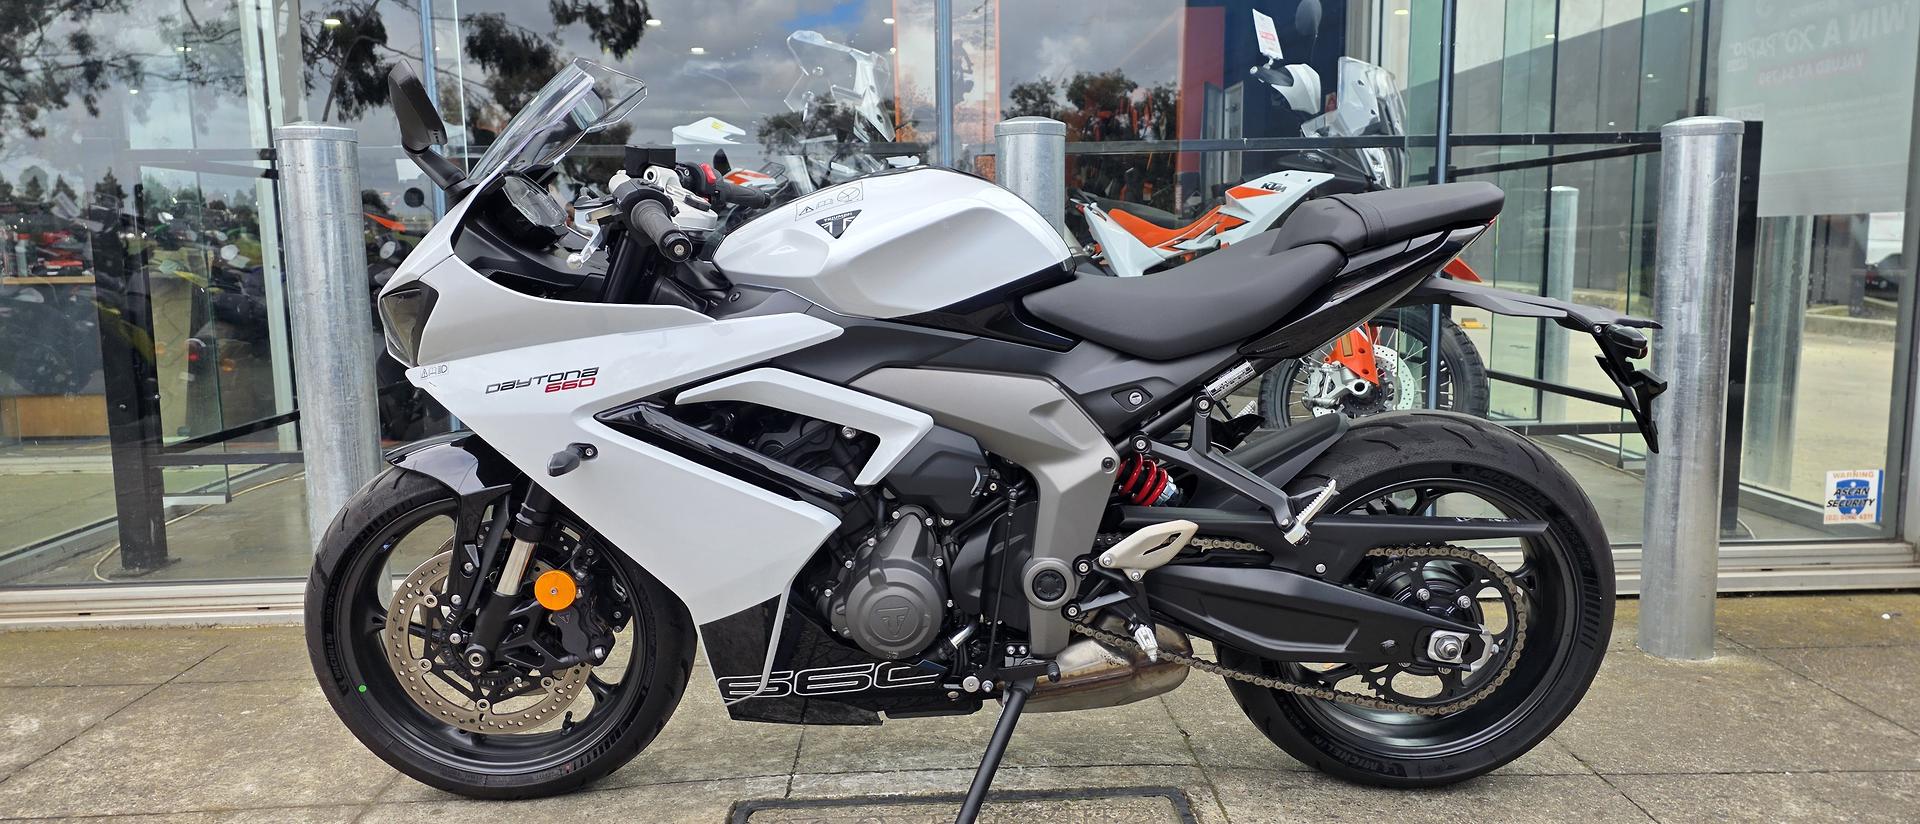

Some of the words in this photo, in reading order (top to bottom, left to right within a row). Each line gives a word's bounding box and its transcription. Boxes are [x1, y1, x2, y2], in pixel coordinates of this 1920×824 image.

[1261, 182, 1287, 192] KTM
[544, 377, 596, 393] 660
[1832, 471, 1874, 479] WARNING
[1833, 488, 1870, 496] ASCAN
[1826, 499, 1875, 508] SECURITY
